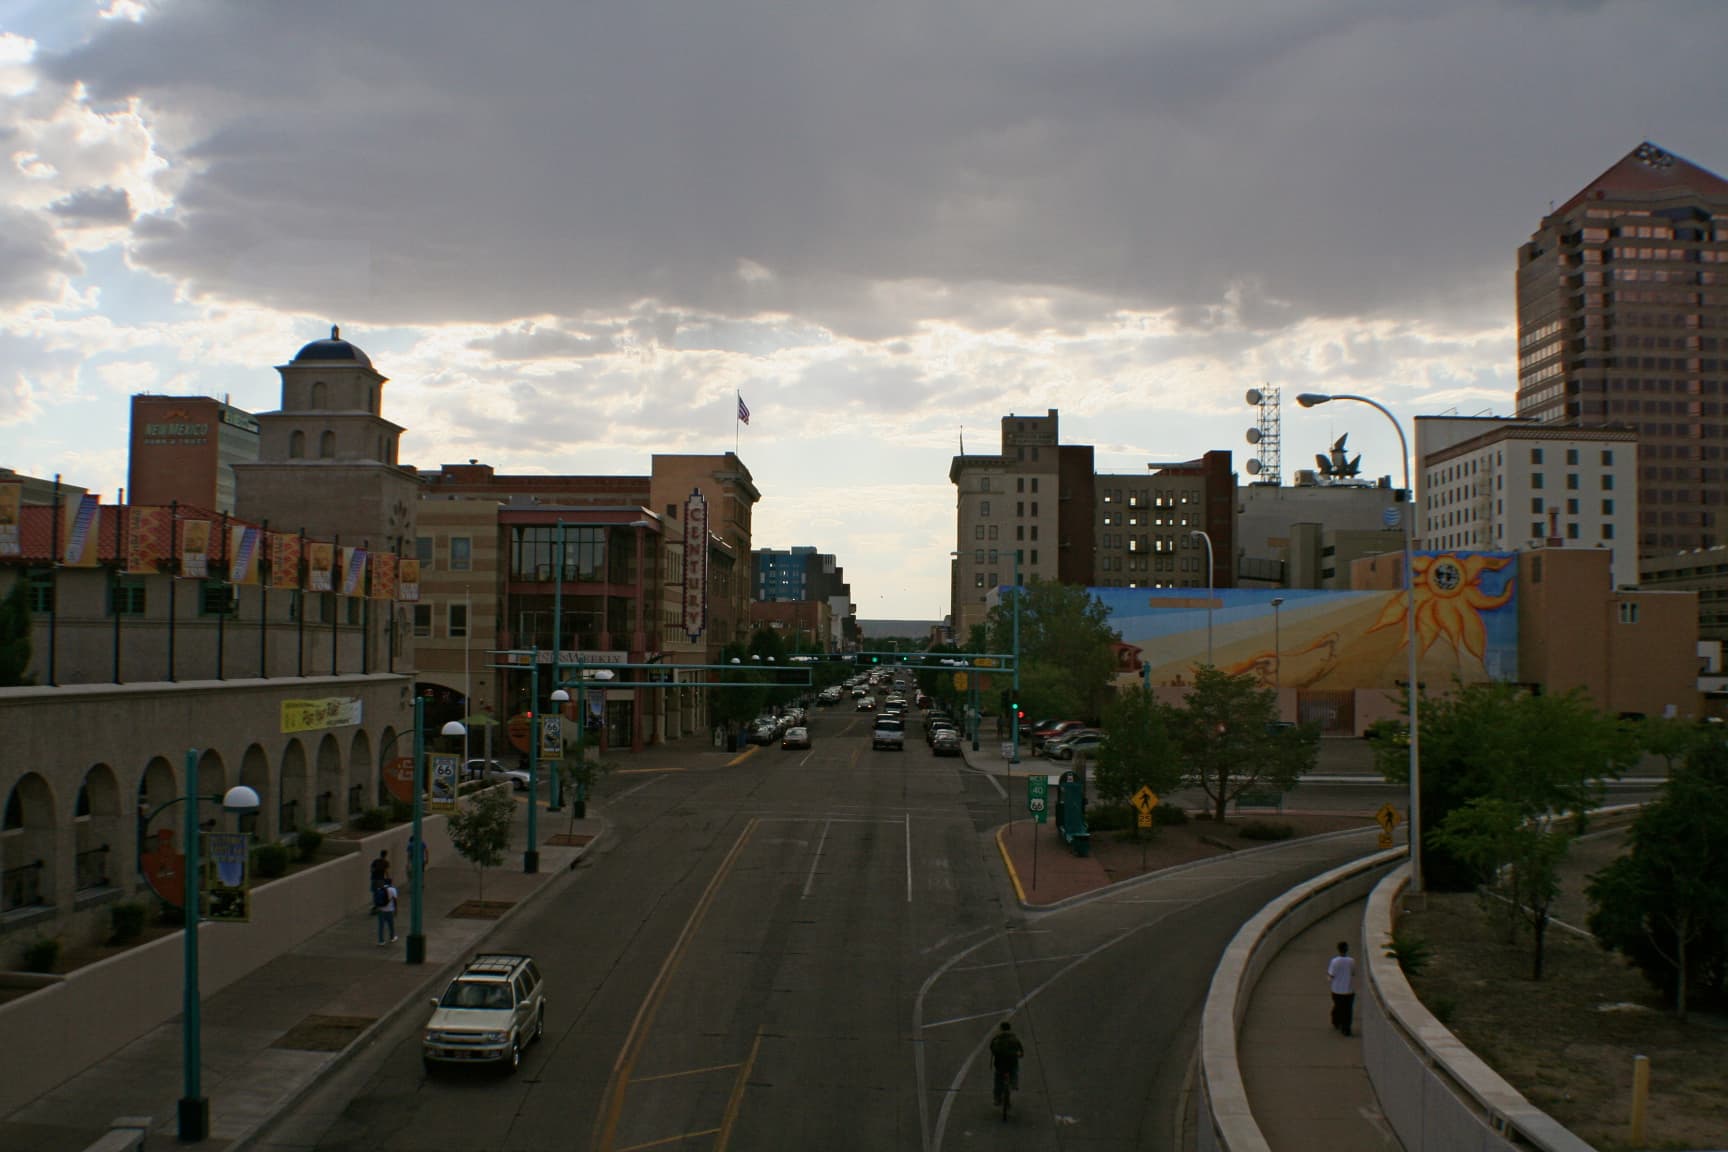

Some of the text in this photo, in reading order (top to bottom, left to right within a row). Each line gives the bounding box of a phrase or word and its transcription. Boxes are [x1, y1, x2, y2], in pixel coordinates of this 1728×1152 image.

[168, 423, 208, 435] MEXICO
[689, 508, 702, 623] CENTURY
[438, 765, 452, 776] 66
[1032, 801, 1042, 810] 66
